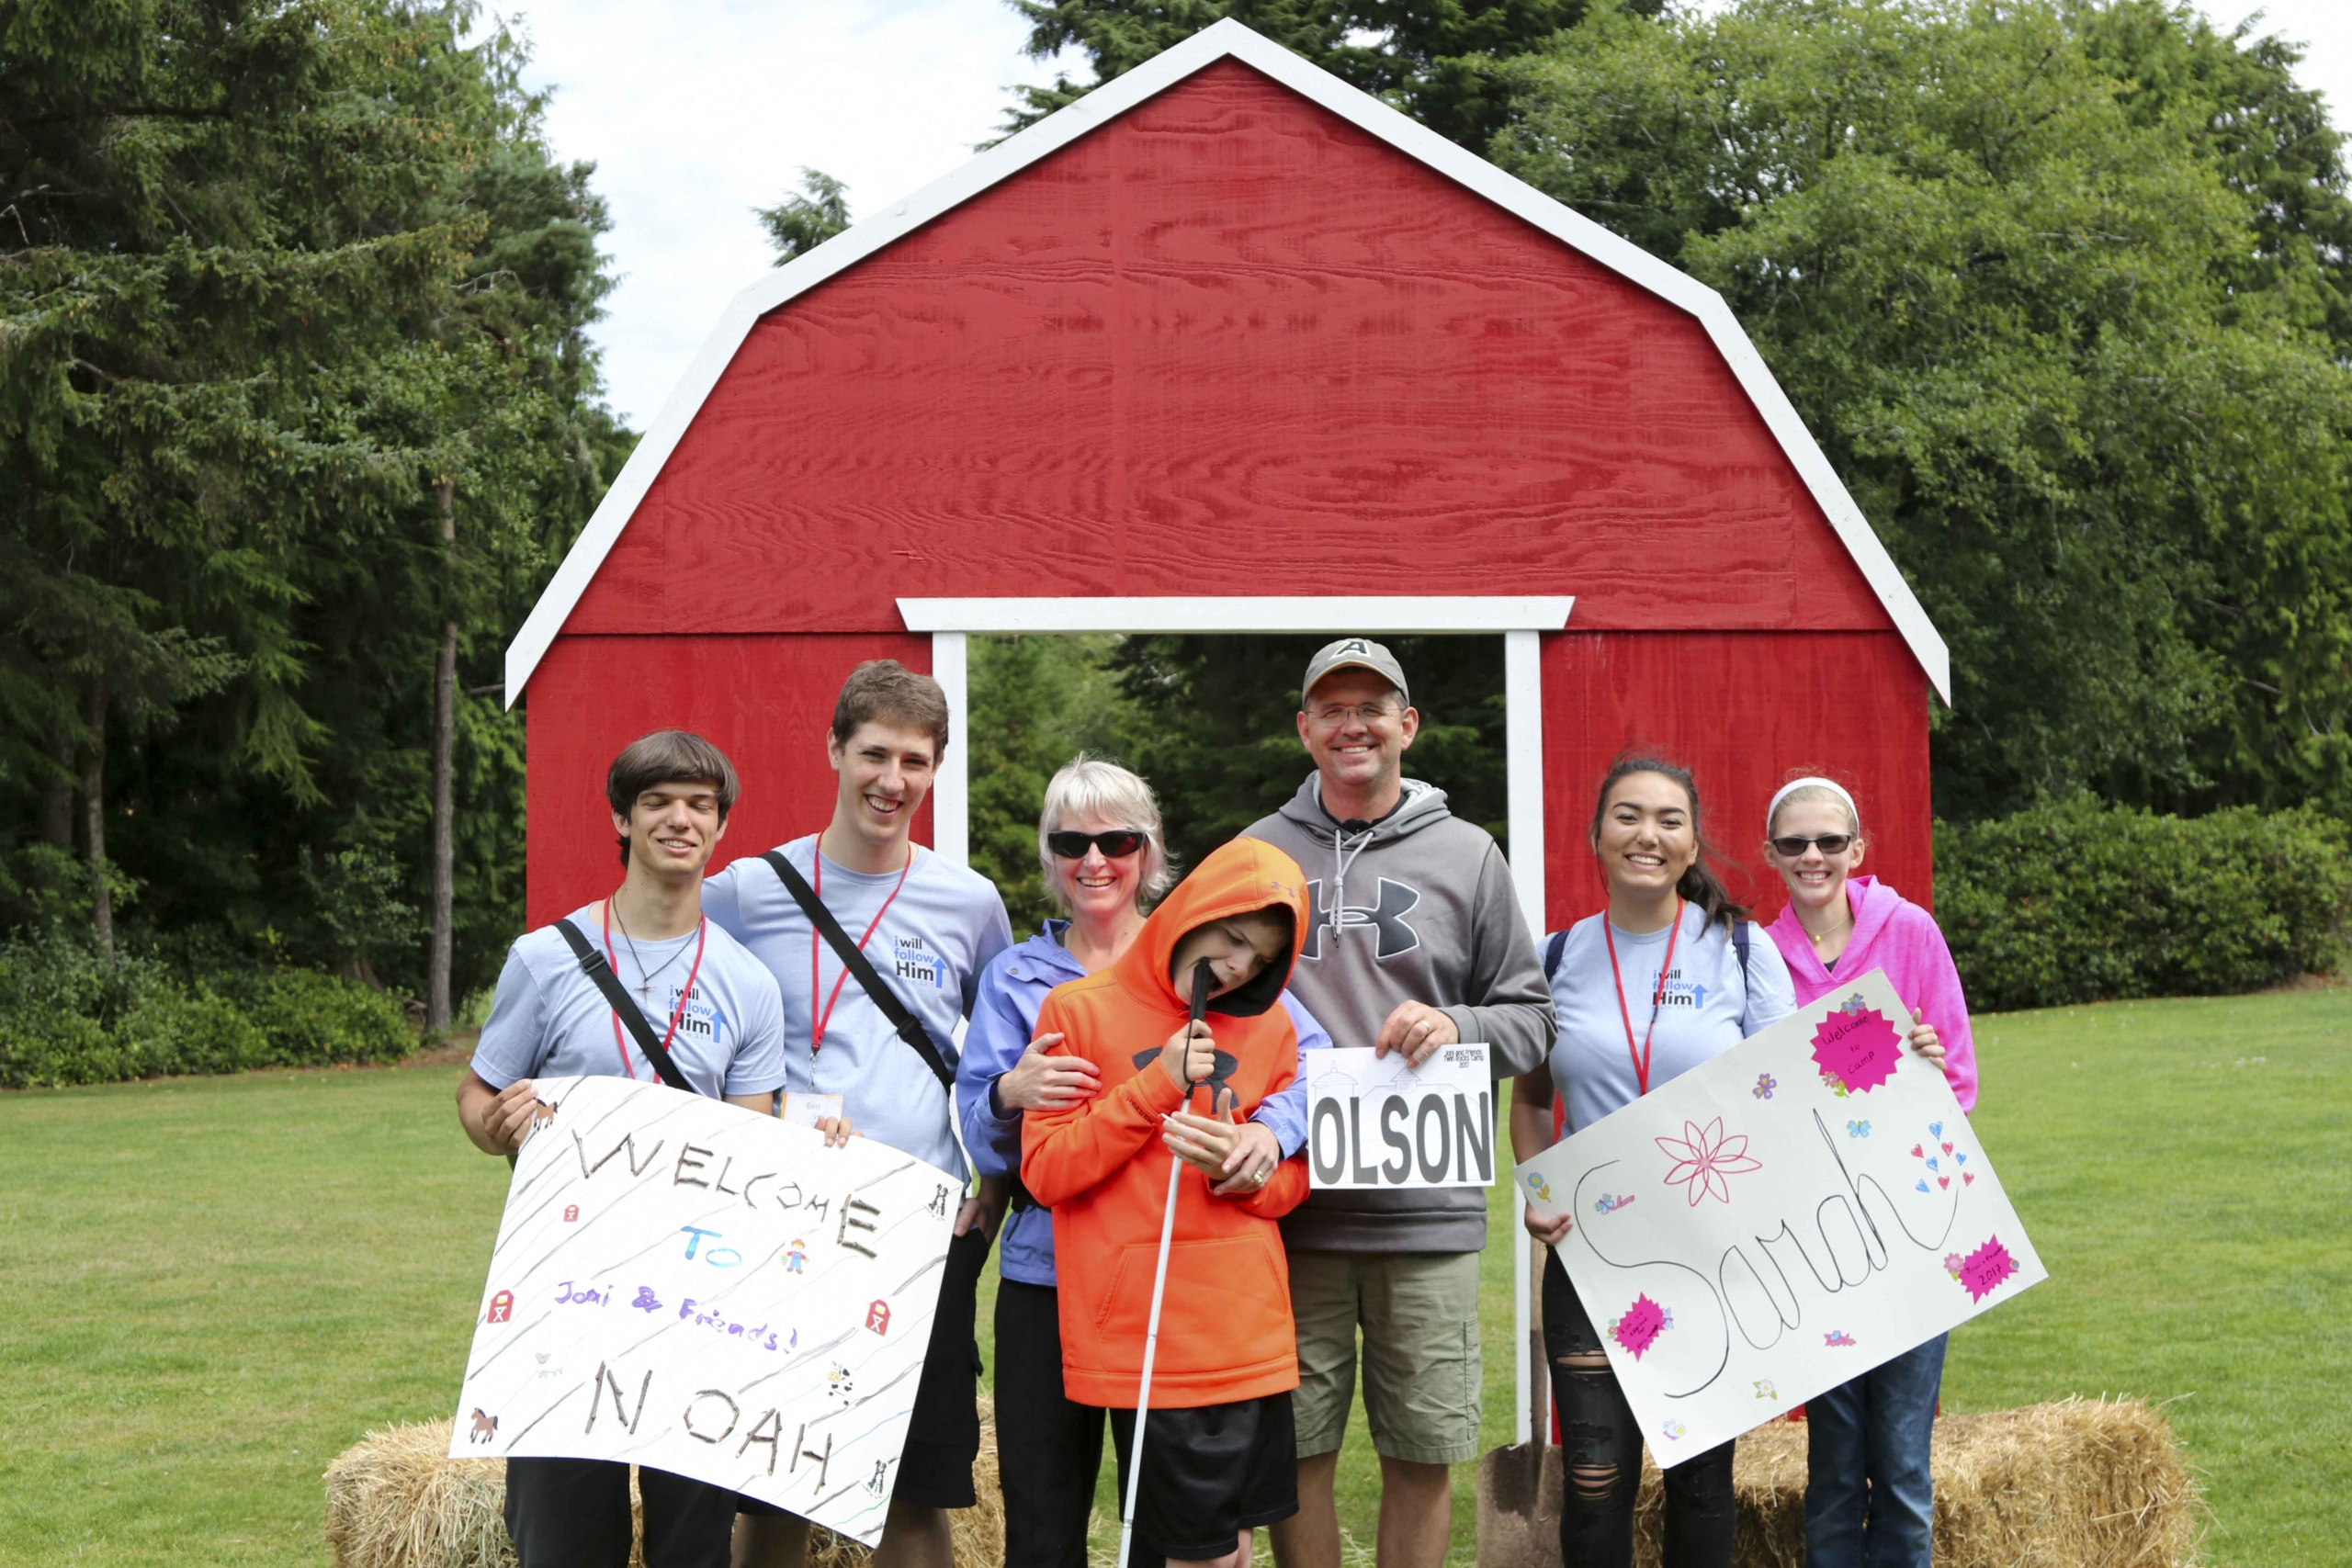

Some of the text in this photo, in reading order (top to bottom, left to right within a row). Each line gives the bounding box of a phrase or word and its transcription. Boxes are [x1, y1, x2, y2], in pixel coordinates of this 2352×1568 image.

[1329, 640, 1371, 659] A
[895, 935, 922, 950] i will
[894, 948, 934, 964] follow
[896, 961, 933, 981] Him
[1654, 969, 1657, 979] i
[670, 985, 673, 996] i
[1653, 991, 1692, 1006] Him
[670, 1011, 710, 1035] Him
[1822, 1016, 1869, 1044] Welcome
[1849, 1043, 1860, 1053] to
[1312, 1091, 1492, 1185] OLSON
[571, 1128, 881, 1258] WELCOME
[680, 1225, 741, 1268] TO
[1575, 1108, 1959, 1398] Sarah
[1978, 1263, 2002, 1286] 2017
[554, 1280, 798, 1355] Joni & Friends!
[585, 1359, 833, 1496] NOAH
